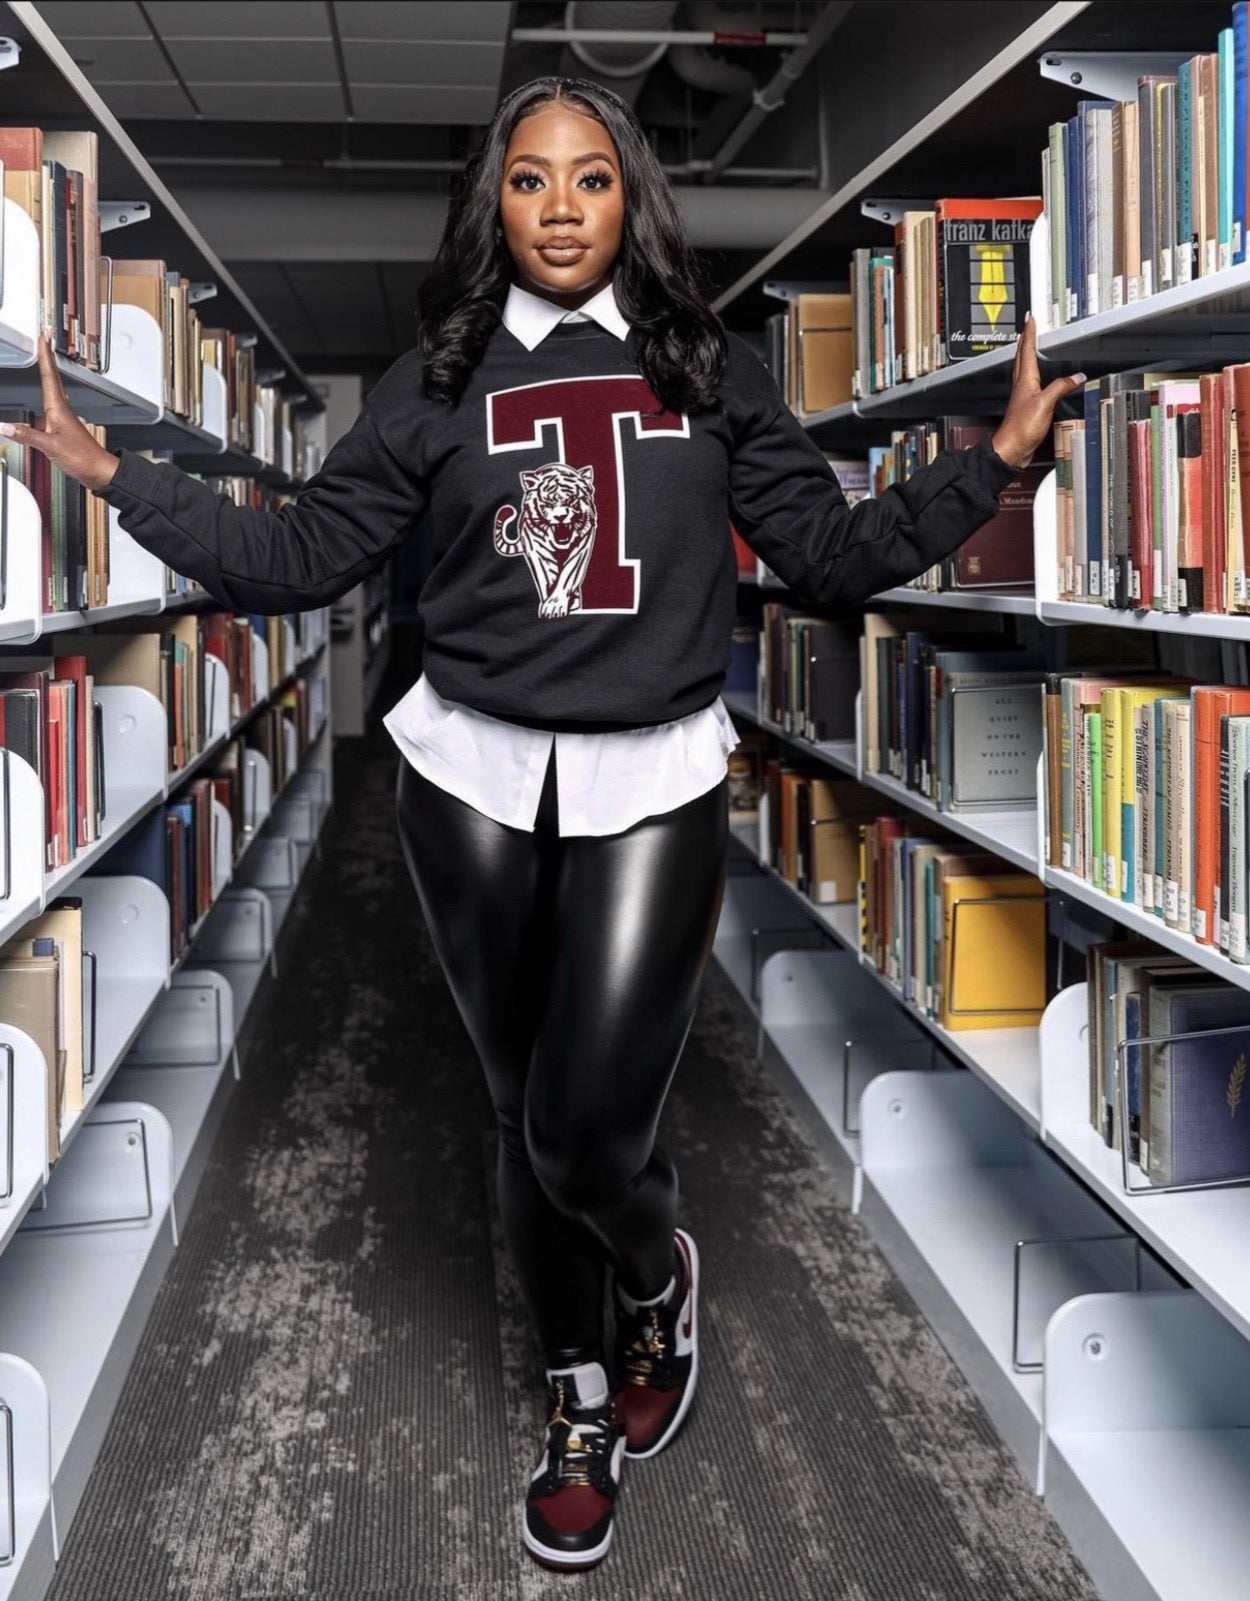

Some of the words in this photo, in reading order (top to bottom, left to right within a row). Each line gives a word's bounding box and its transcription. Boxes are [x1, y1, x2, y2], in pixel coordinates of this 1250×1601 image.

[945, 218, 986, 241] franz
[950, 330, 966, 341] the
[967, 330, 1006, 344] complete
[485, 374, 691, 615] T
